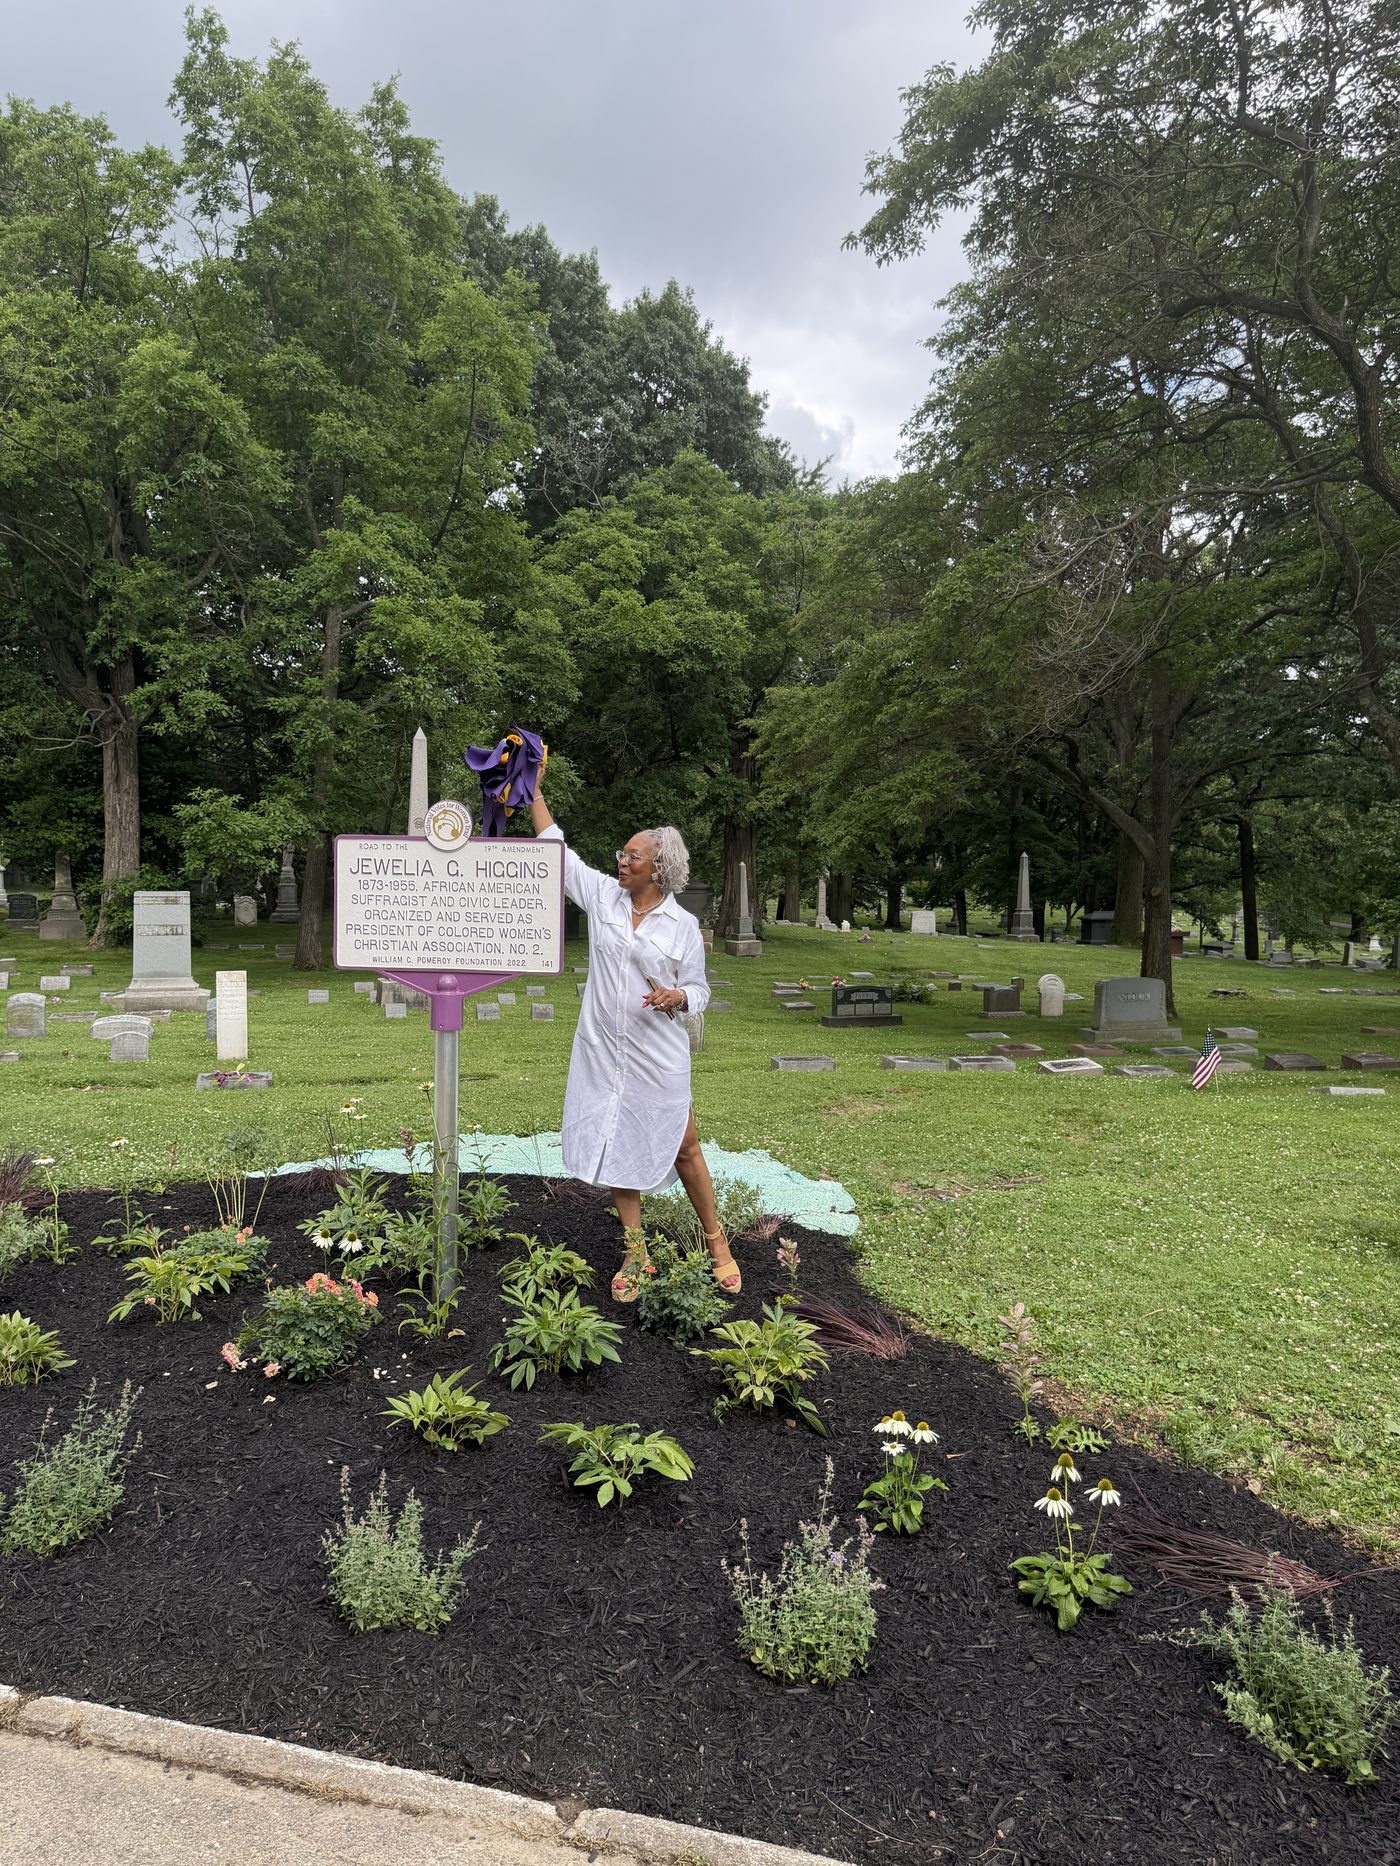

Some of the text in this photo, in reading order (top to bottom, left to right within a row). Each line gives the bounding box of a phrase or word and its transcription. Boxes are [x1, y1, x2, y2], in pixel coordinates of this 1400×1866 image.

[430, 804, 446, 813] Votes
[454, 803, 470, 824] Women
[462, 825, 471, 838] Trail
[350, 858, 549, 878] JEWELIA G. HIGGINS
[423, 881, 474, 892] AFRICAN
[479, 882, 540, 894] AMERICAN
[352, 894, 427, 906] SUFFRAGIST
[431, 896, 454, 907] AND
[460, 897, 490, 908] CIVIC
[364, 909, 533, 924] ORGANIZED AND SERVED AS
[346, 924, 552, 940] PRESIDENT OF COLORED WOMEN'S
[354, 939, 418, 951] CHRISTIAN
[510, 944, 528, 954] NO.
[532, 944, 543, 955] 2.
[456, 958, 502, 966] FOUNDATION
